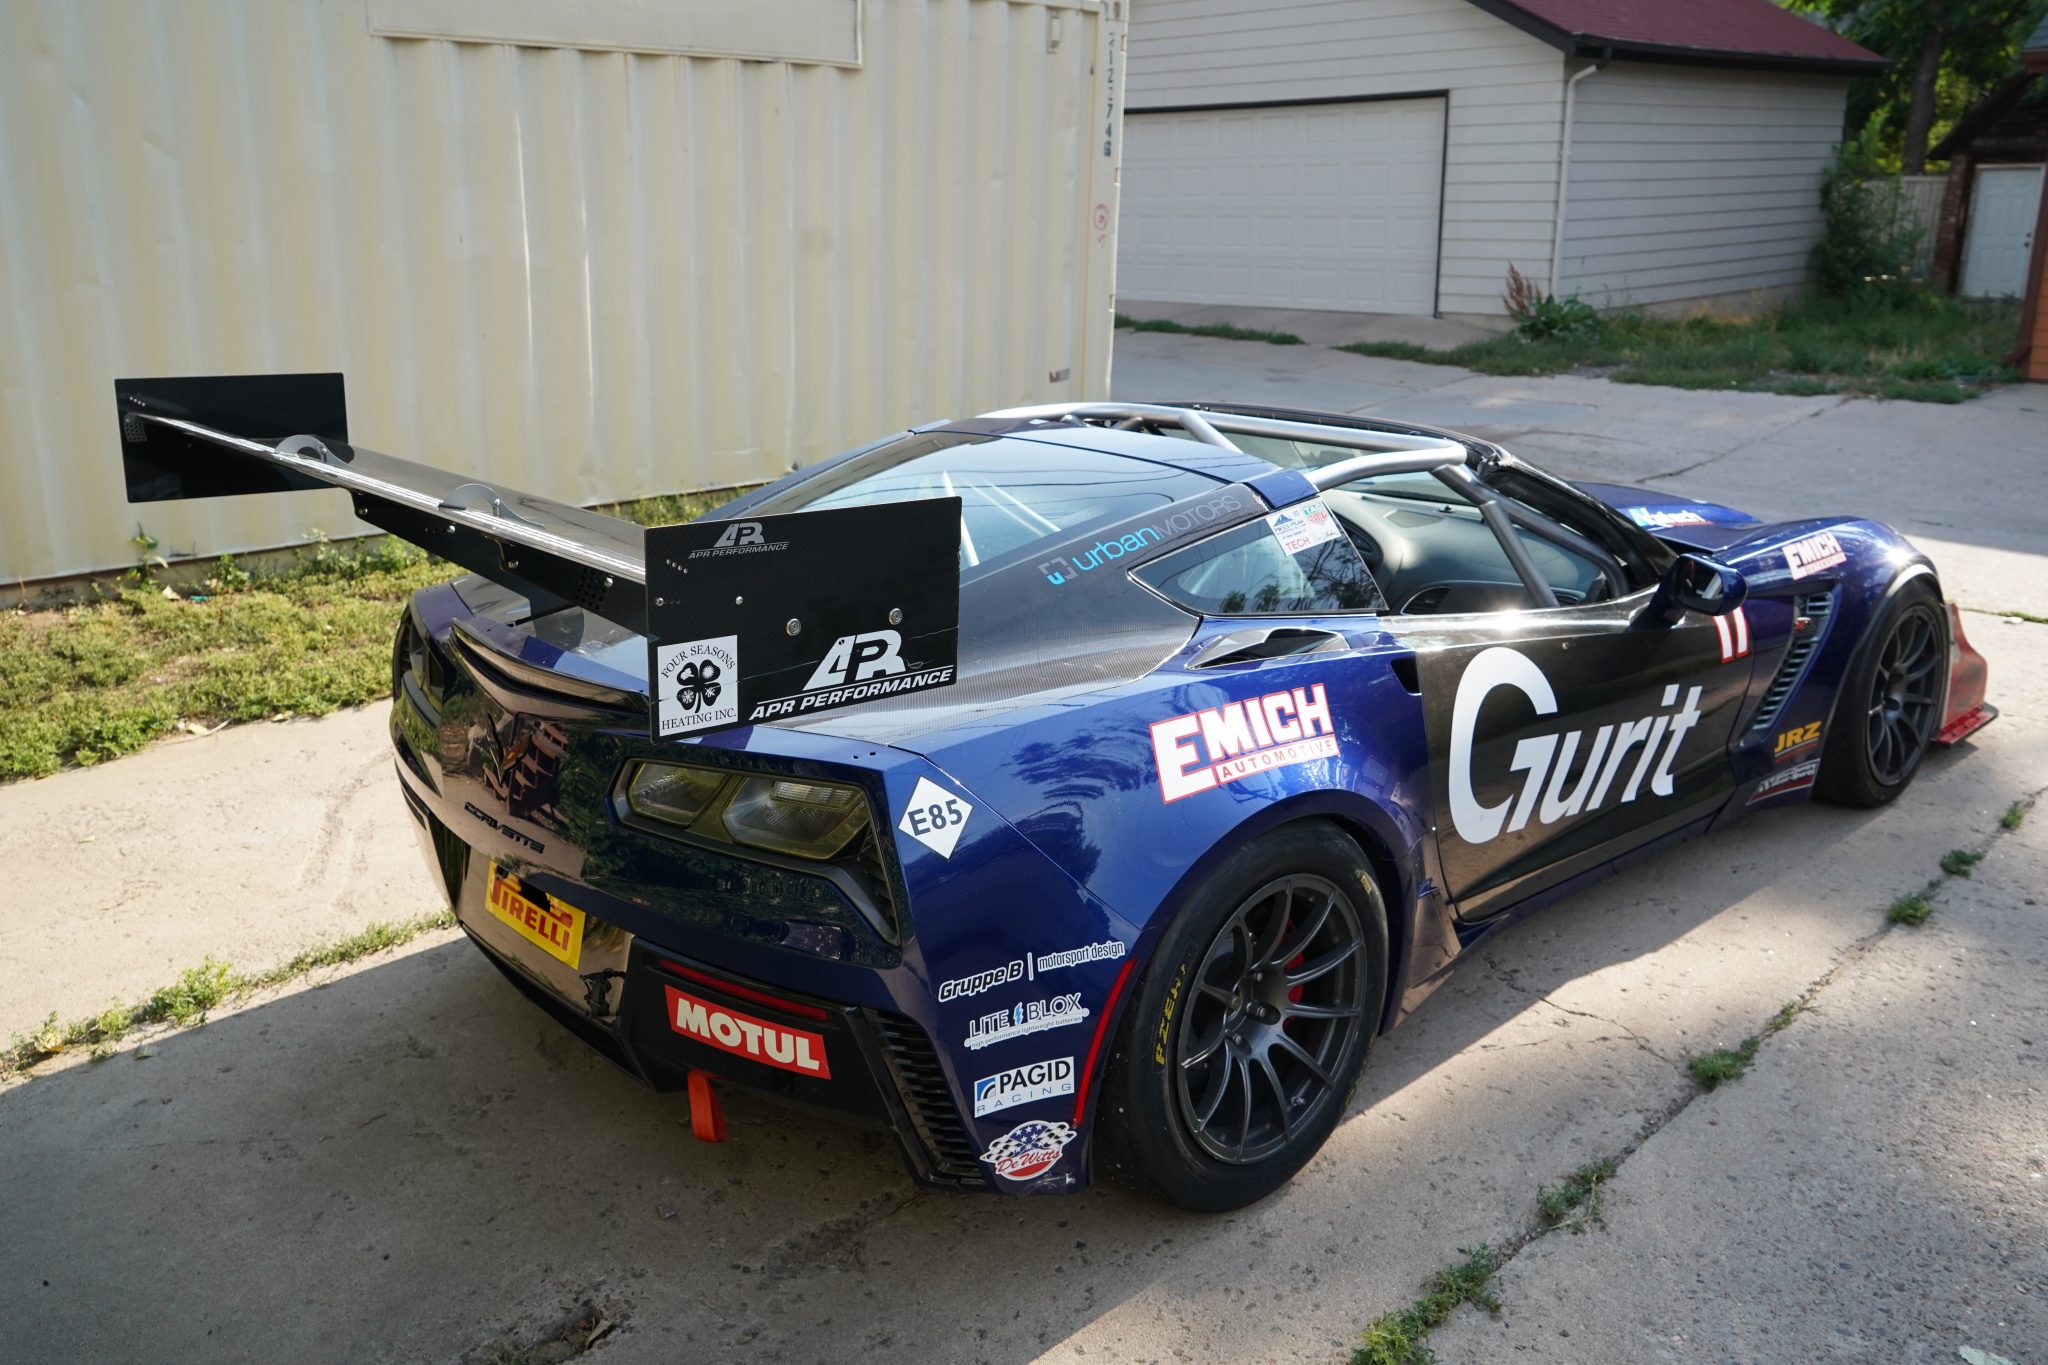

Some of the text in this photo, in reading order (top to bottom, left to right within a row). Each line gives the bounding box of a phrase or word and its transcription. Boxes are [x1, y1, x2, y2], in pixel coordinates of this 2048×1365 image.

[688, 543, 790, 560] APR PERFORMANCE
[1285, 536, 1311, 551] TECH
[1781, 532, 1842, 581] EMICH
[661, 645, 736, 679] FOUR SEASONS
[748, 669, 954, 721] APR PERFORMANCE
[661, 707, 737, 730] HEATING INC.
[1774, 721, 1821, 753] JRZ
[1150, 683, 1334, 805] EMICH
[1222, 739, 1334, 779] AUTOMOTIVE
[1448, 646, 1702, 844] Gurit
[908, 798, 963, 836] E85
[939, 941, 1125, 1001] Gruppe B motorsport design
[676, 997, 820, 1071] MOTUL
[970, 992, 1082, 1038] LITE BLOX
[985, 1029, 1021, 1046] performance
[1021, 1020, 1055, 1035] lightweight
[1055, 1016, 1082, 1026] batteries
[1000, 1060, 1071, 1094] PAGID
[976, 1083, 1072, 1114] RACING
